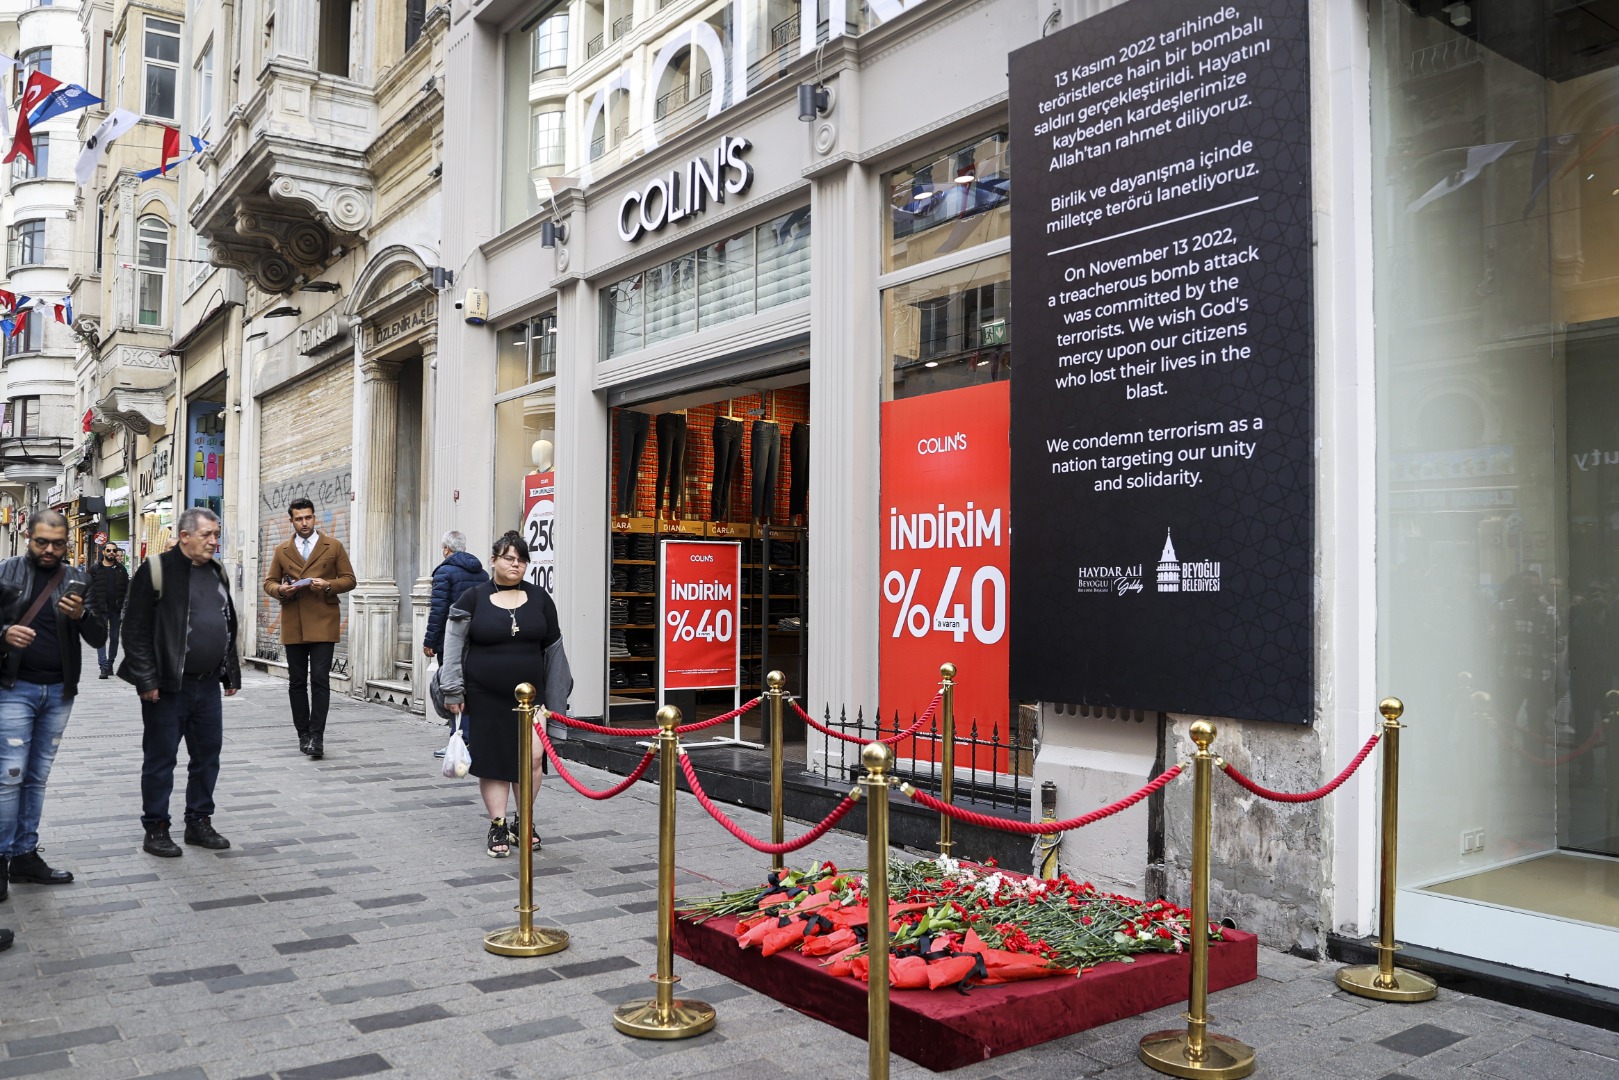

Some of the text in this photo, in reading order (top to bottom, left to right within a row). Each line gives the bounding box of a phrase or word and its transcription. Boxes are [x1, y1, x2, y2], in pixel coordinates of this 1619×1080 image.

[1038, 16, 1263, 114] teröristlerce hain bir bombalı
[1054, 6, 1240, 88] 13 Kasım 2022 tarihinde,
[1034, 39, 1270, 136] saldırı gerçekleştirildi. Hayatını
[1049, 94, 1252, 172] Allah'tan rahmet diliyoruz.
[1053, 72, 1247, 150] kaybeden kardeşlerimize
[618, 136, 753, 243] COLIN'S
[1051, 139, 1253, 212] Birlik ve dayanışma içinde
[1047, 163, 1259, 234] milletçe terörü lanetliyoruz.
[1048, 245, 1259, 307] a treacherous bomb attack
[1064, 228, 1237, 282] On November 13 2022,
[1057, 297, 1249, 347] terrorists. We wish God's
[1063, 276, 1239, 324] was committed by the
[376, 315, 411, 344] ÖZLENİR
[1059, 323, 1247, 367] mercy upon our citizens
[1055, 345, 1251, 389] who lost their lives in the
[1127, 381, 1168, 400] blast.
[918, 432, 967, 455] COLIN'S
[1046, 417, 1263, 453] We condemn terrorism as a
[1052, 440, 1256, 474] nation targeting our unity
[1094, 469, 1202, 491] and solidarity.
[663, 524, 686, 532] DIANA
[711, 527, 735, 535] CARLA
[890, 501, 1001, 550] İNDİRİM
[671, 579, 731, 601] İNDİRİM
[1079, 563, 1142, 578] HAYDAR ALİ
[1182, 558, 1221, 578] BEYOĞLU
[1182, 578, 1220, 592] BELEDİYESİ
[667, 609, 732, 642] %40
[883, 566, 1006, 644] %40
[942, 619, 960, 628] varan
